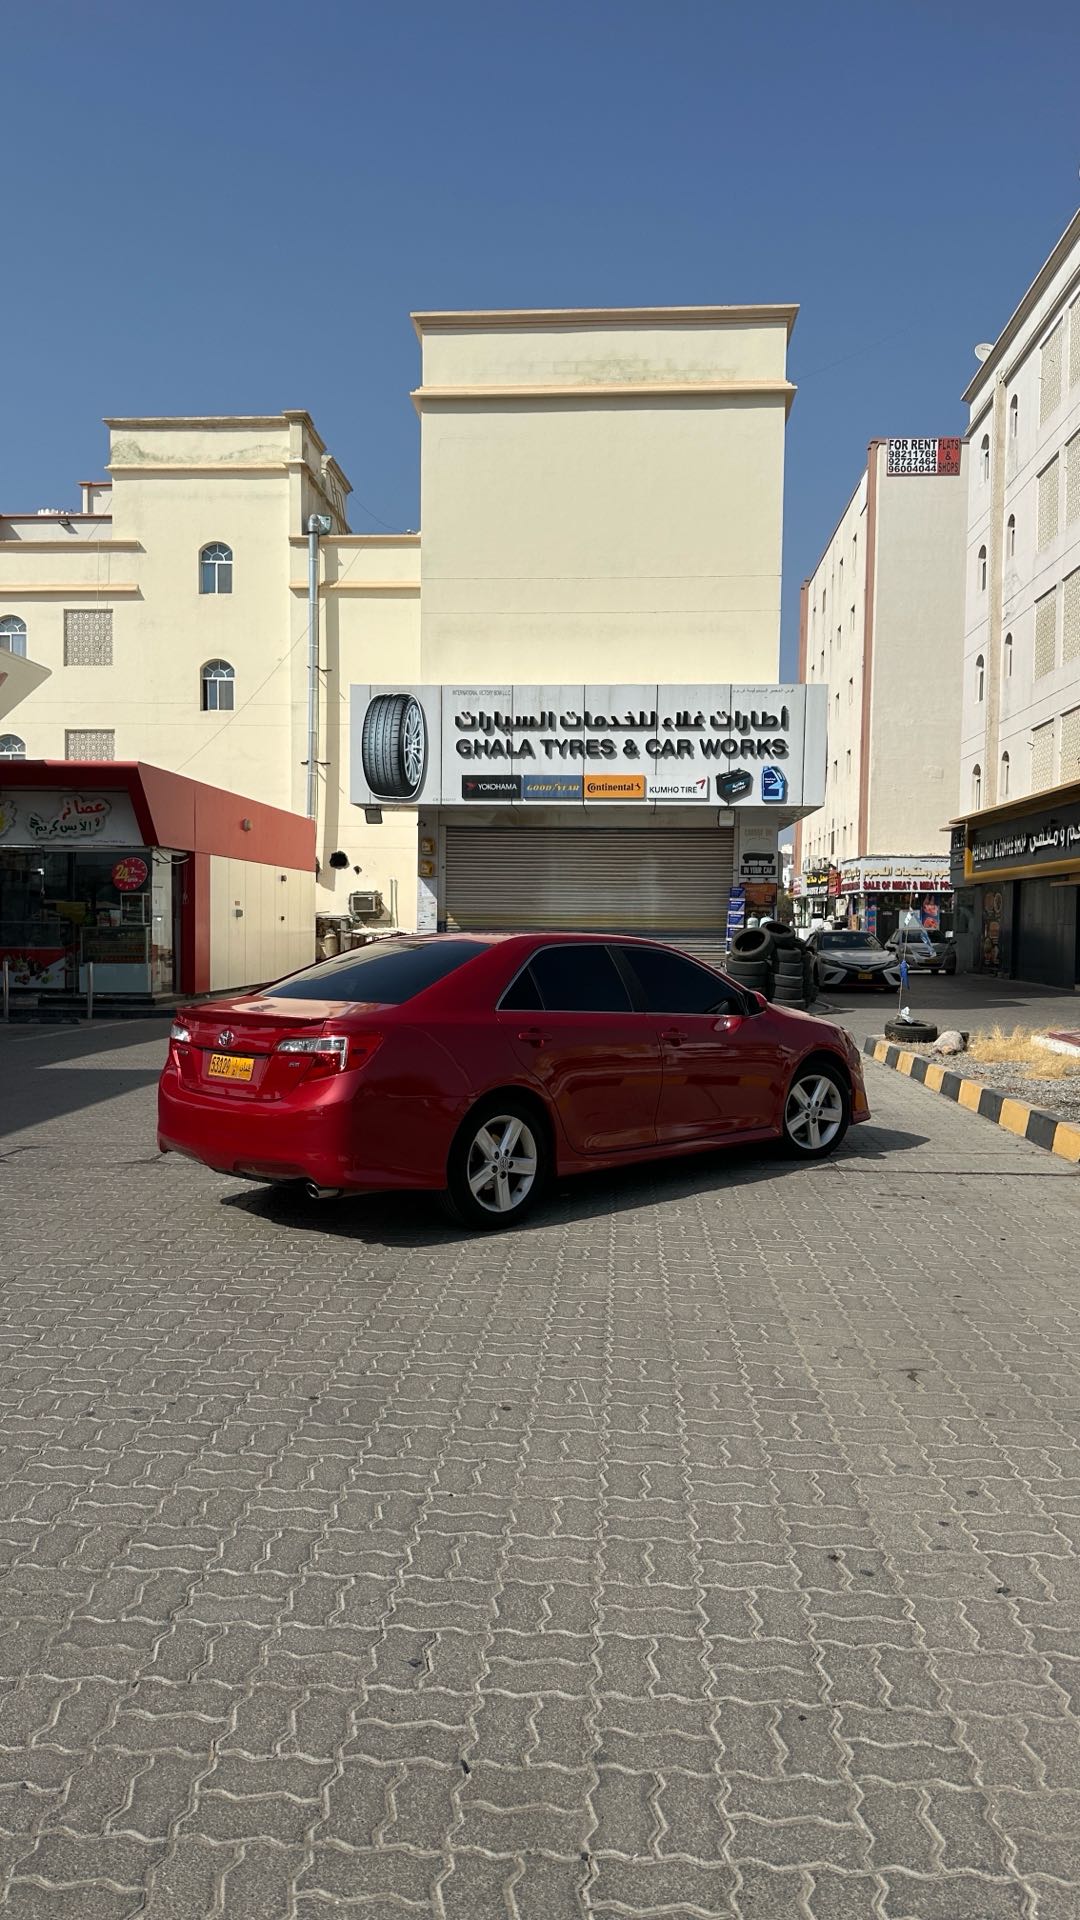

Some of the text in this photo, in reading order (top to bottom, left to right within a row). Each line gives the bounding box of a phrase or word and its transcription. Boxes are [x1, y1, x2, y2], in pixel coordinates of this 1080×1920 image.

[889, 440, 937, 450] FOR RENT
[938, 439, 959, 450] FLATS
[888, 450, 937, 458] 98211768
[945, 451, 951, 460] &
[888, 465, 937, 473] 96004044
[938, 462, 959, 473] SHOPS
[455, 711, 556, 736] السيارات
[560, 711, 659, 731] للخدمات
[455, 738, 789, 759] GHALA TYRES & CAR WORKS
[478, 783, 518, 791] YOKOHAMA
[587, 782, 634, 793] Continental
[649, 786, 698, 794] KUMHO TIRE
[115, 864, 129, 881] 24
[863, 881, 880, 890] SALE
[882, 881, 891, 890] OF
[892, 881, 912, 890] MEAT
[912, 881, 918, 890] &
[920, 881, 939, 890] MEAT
